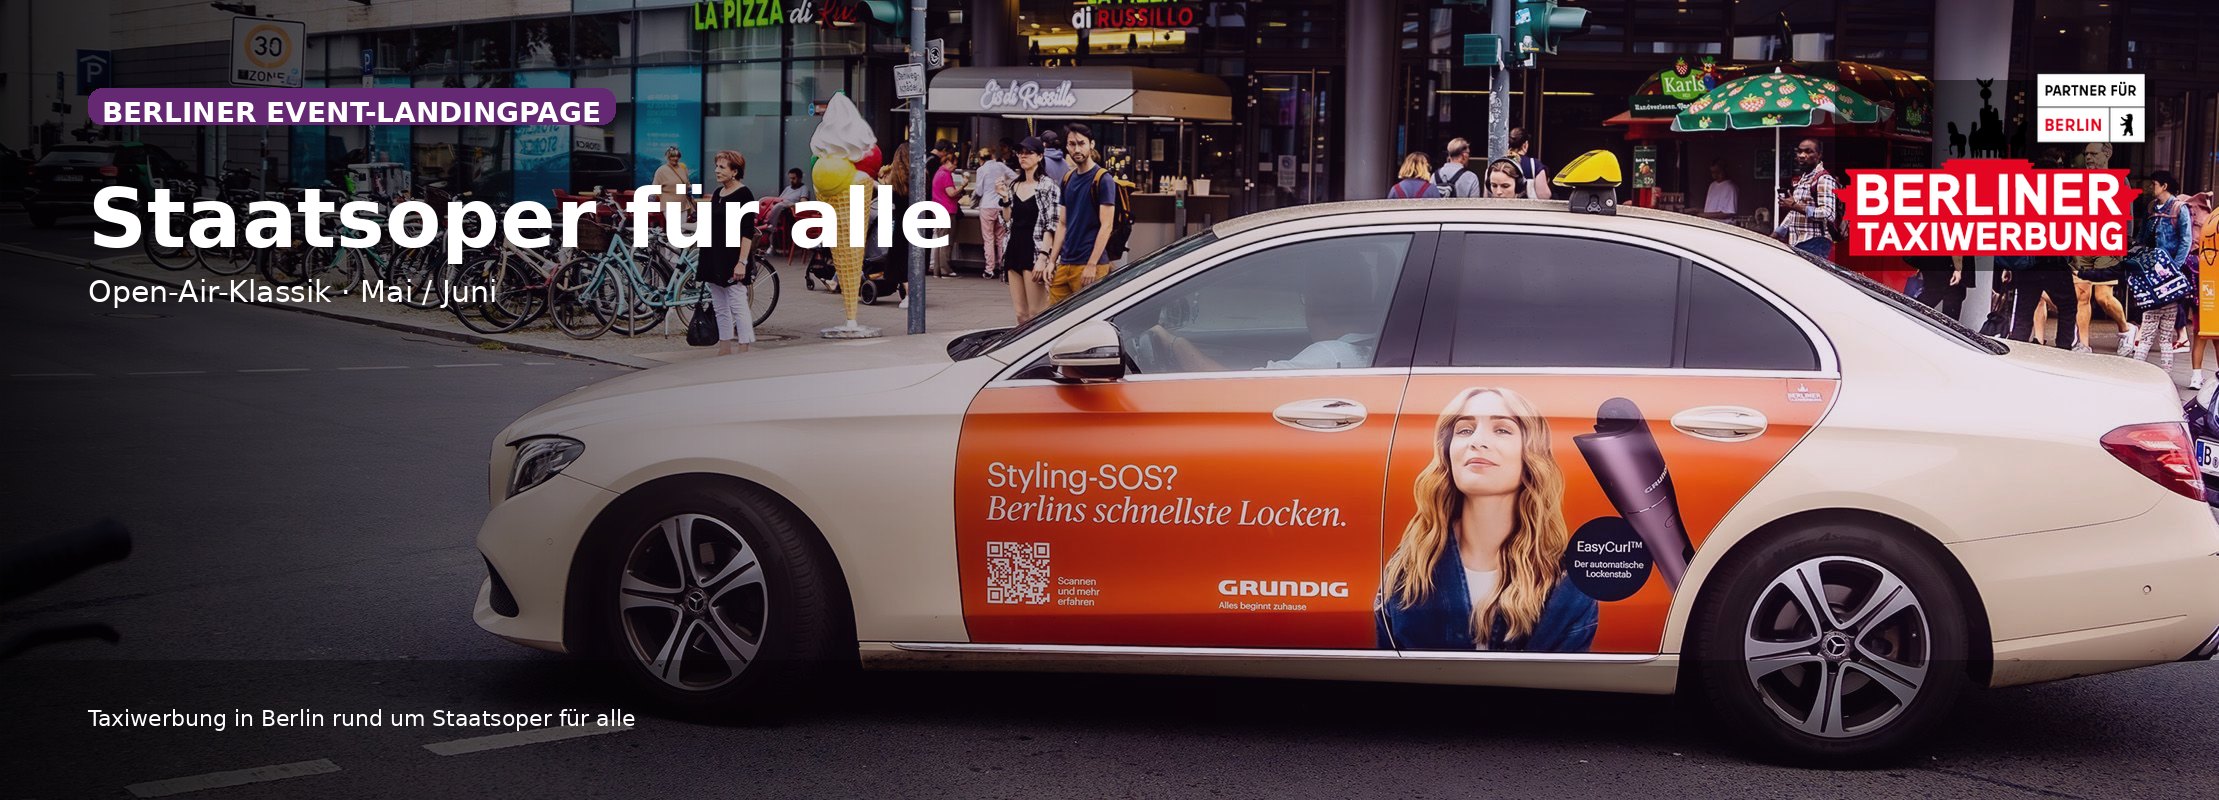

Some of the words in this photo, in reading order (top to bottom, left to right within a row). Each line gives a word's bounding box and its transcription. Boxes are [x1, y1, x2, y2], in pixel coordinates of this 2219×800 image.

[694, 1, 718, 30] LA
[723, 0, 784, 28] PIZZA
[789, 0, 813, 24] di
[1072, 6, 1092, 29] di
[1097, 7, 1193, 28] RUSSILLO
[254, 36, 282, 57] 30
[1664, 75, 1706, 93] Karls
[981, 80, 1004, 109] Eis
[1003, 80, 1019, 106] di
[1019, 80, 1077, 109] Russillo
[987, 461, 1178, 495] Styling-SOS?
[987, 496, 1086, 523] Berlins
[1093, 498, 1232, 526] schnellste
[1238, 500, 1347, 527] Locken.
[1574, 560, 1588, 569] Der
[1590, 560, 1644, 569] automatische
[1057, 577, 1097, 586] Scannen
[1586, 570, 1632, 579] Lockenstab
[1057, 587, 1077, 596] und
[1078, 587, 1100, 596] mehr
[1218, 579, 1348, 597] GRUNDIG
[1057, 597, 1095, 606] erfahren
[1218, 602, 1237, 610] Alles
[1239, 602, 1271, 612] beginnt
[1273, 602, 1307, 611] zuhause
